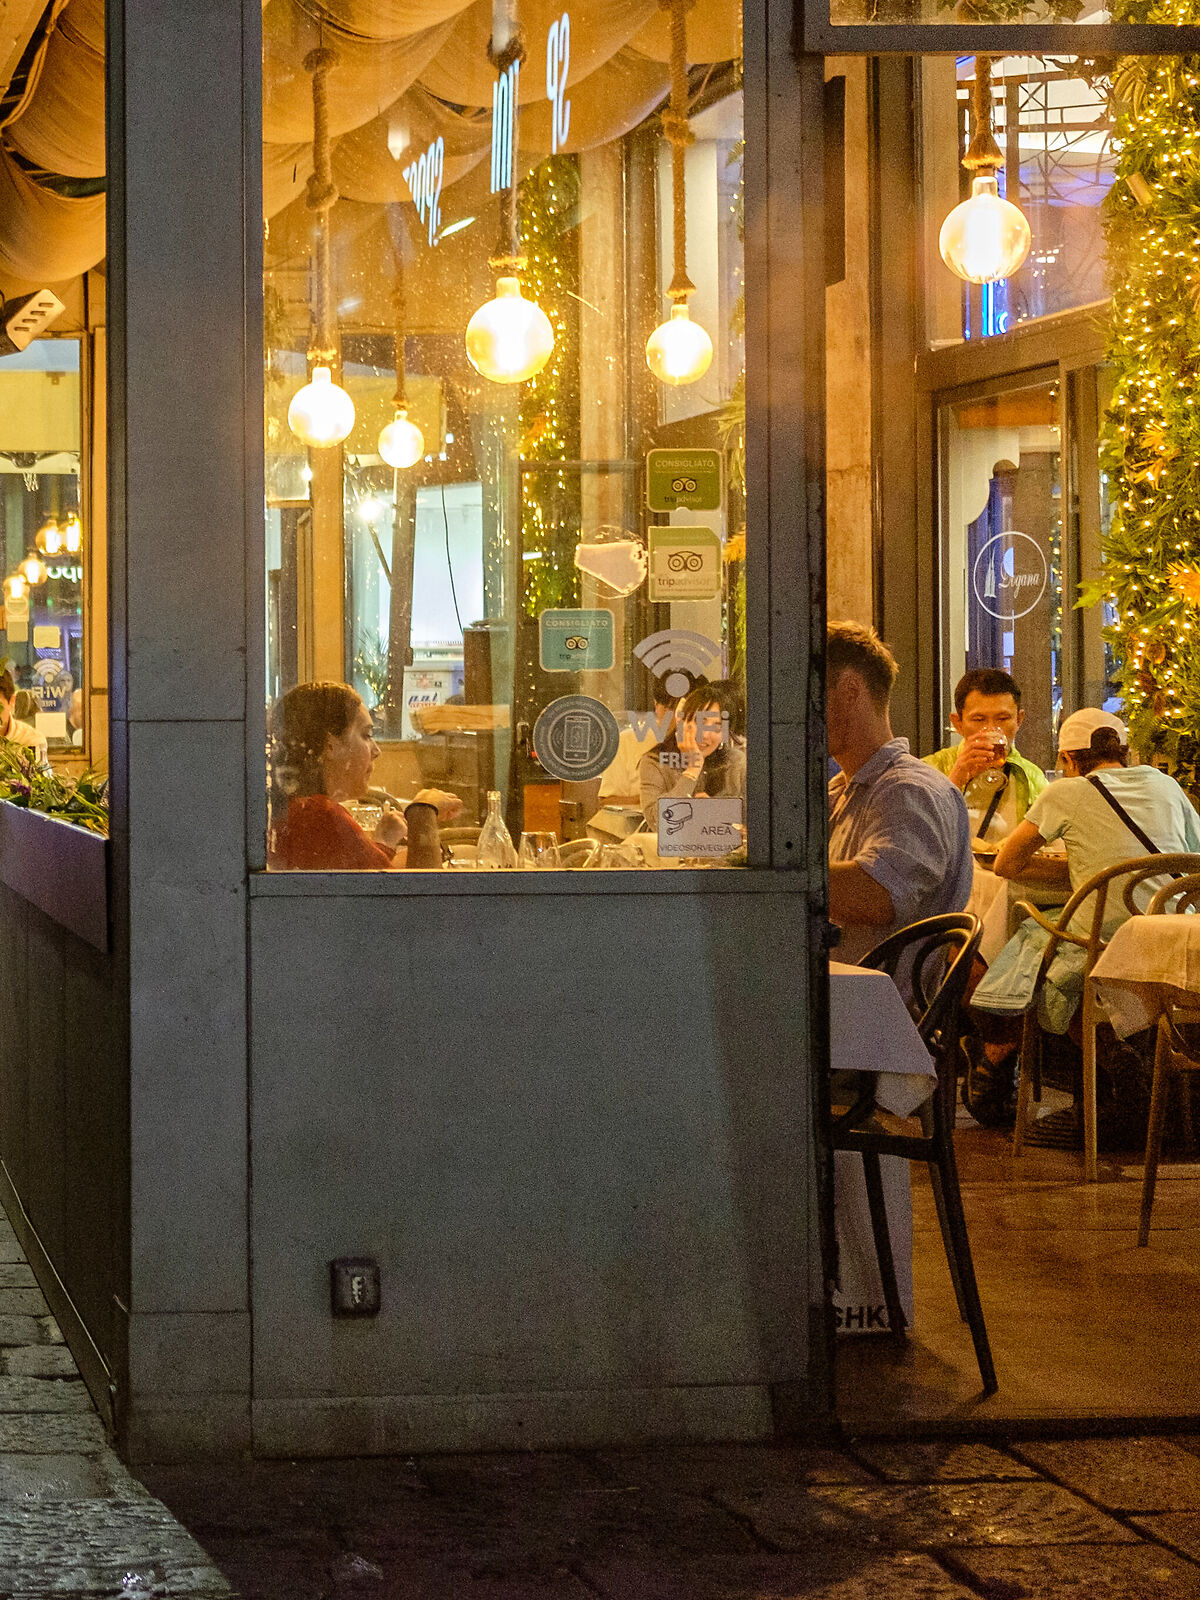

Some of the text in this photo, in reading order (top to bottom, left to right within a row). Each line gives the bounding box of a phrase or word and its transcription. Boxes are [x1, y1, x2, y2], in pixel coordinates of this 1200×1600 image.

[545, 619, 609, 627] CONSIGLIATO
[659, 752, 701, 769] FREE
[701, 825, 732, 836] AREA
